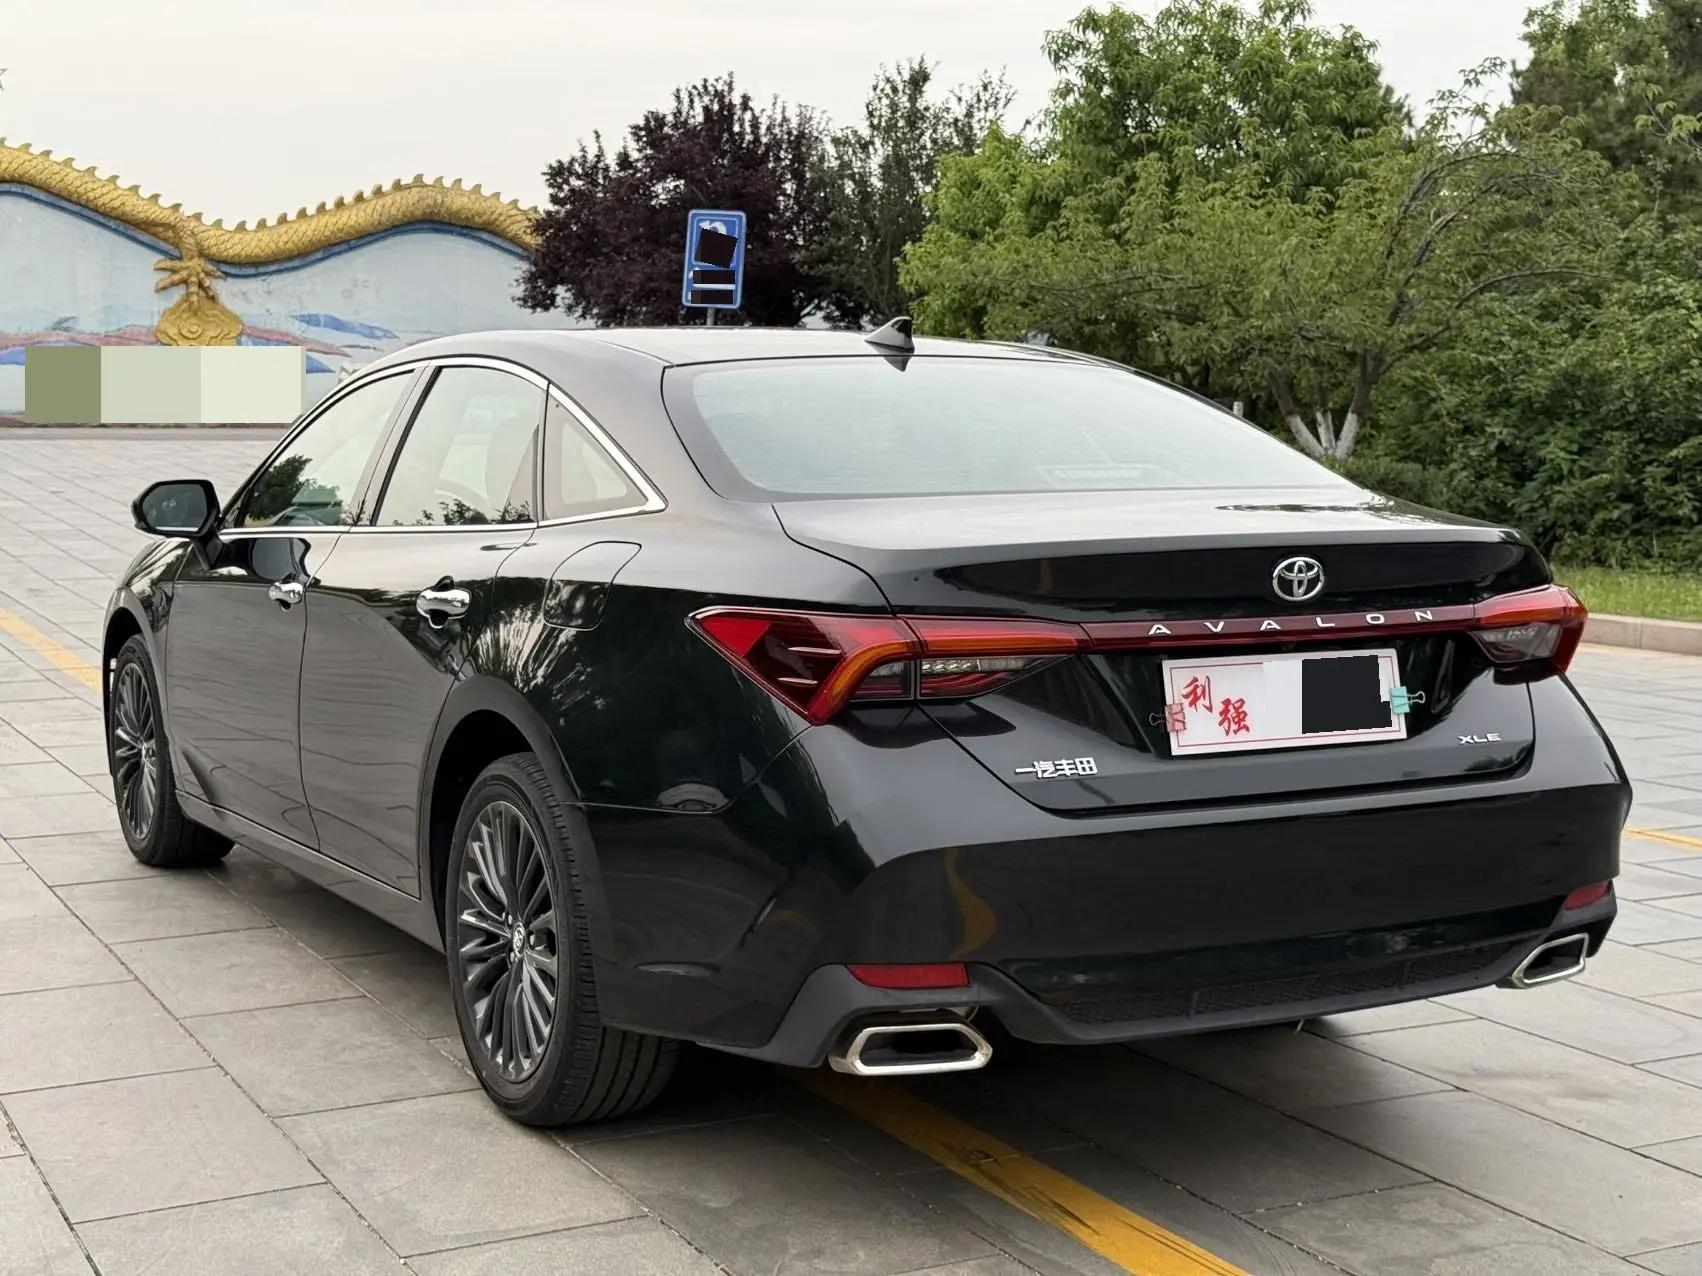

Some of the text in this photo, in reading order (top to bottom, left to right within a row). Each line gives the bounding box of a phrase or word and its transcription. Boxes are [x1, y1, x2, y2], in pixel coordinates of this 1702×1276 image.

[1148, 610, 1433, 635] AVALON
[1457, 733, 1502, 744] XLE
[1015, 757, 1098, 778] 一汽丰田
